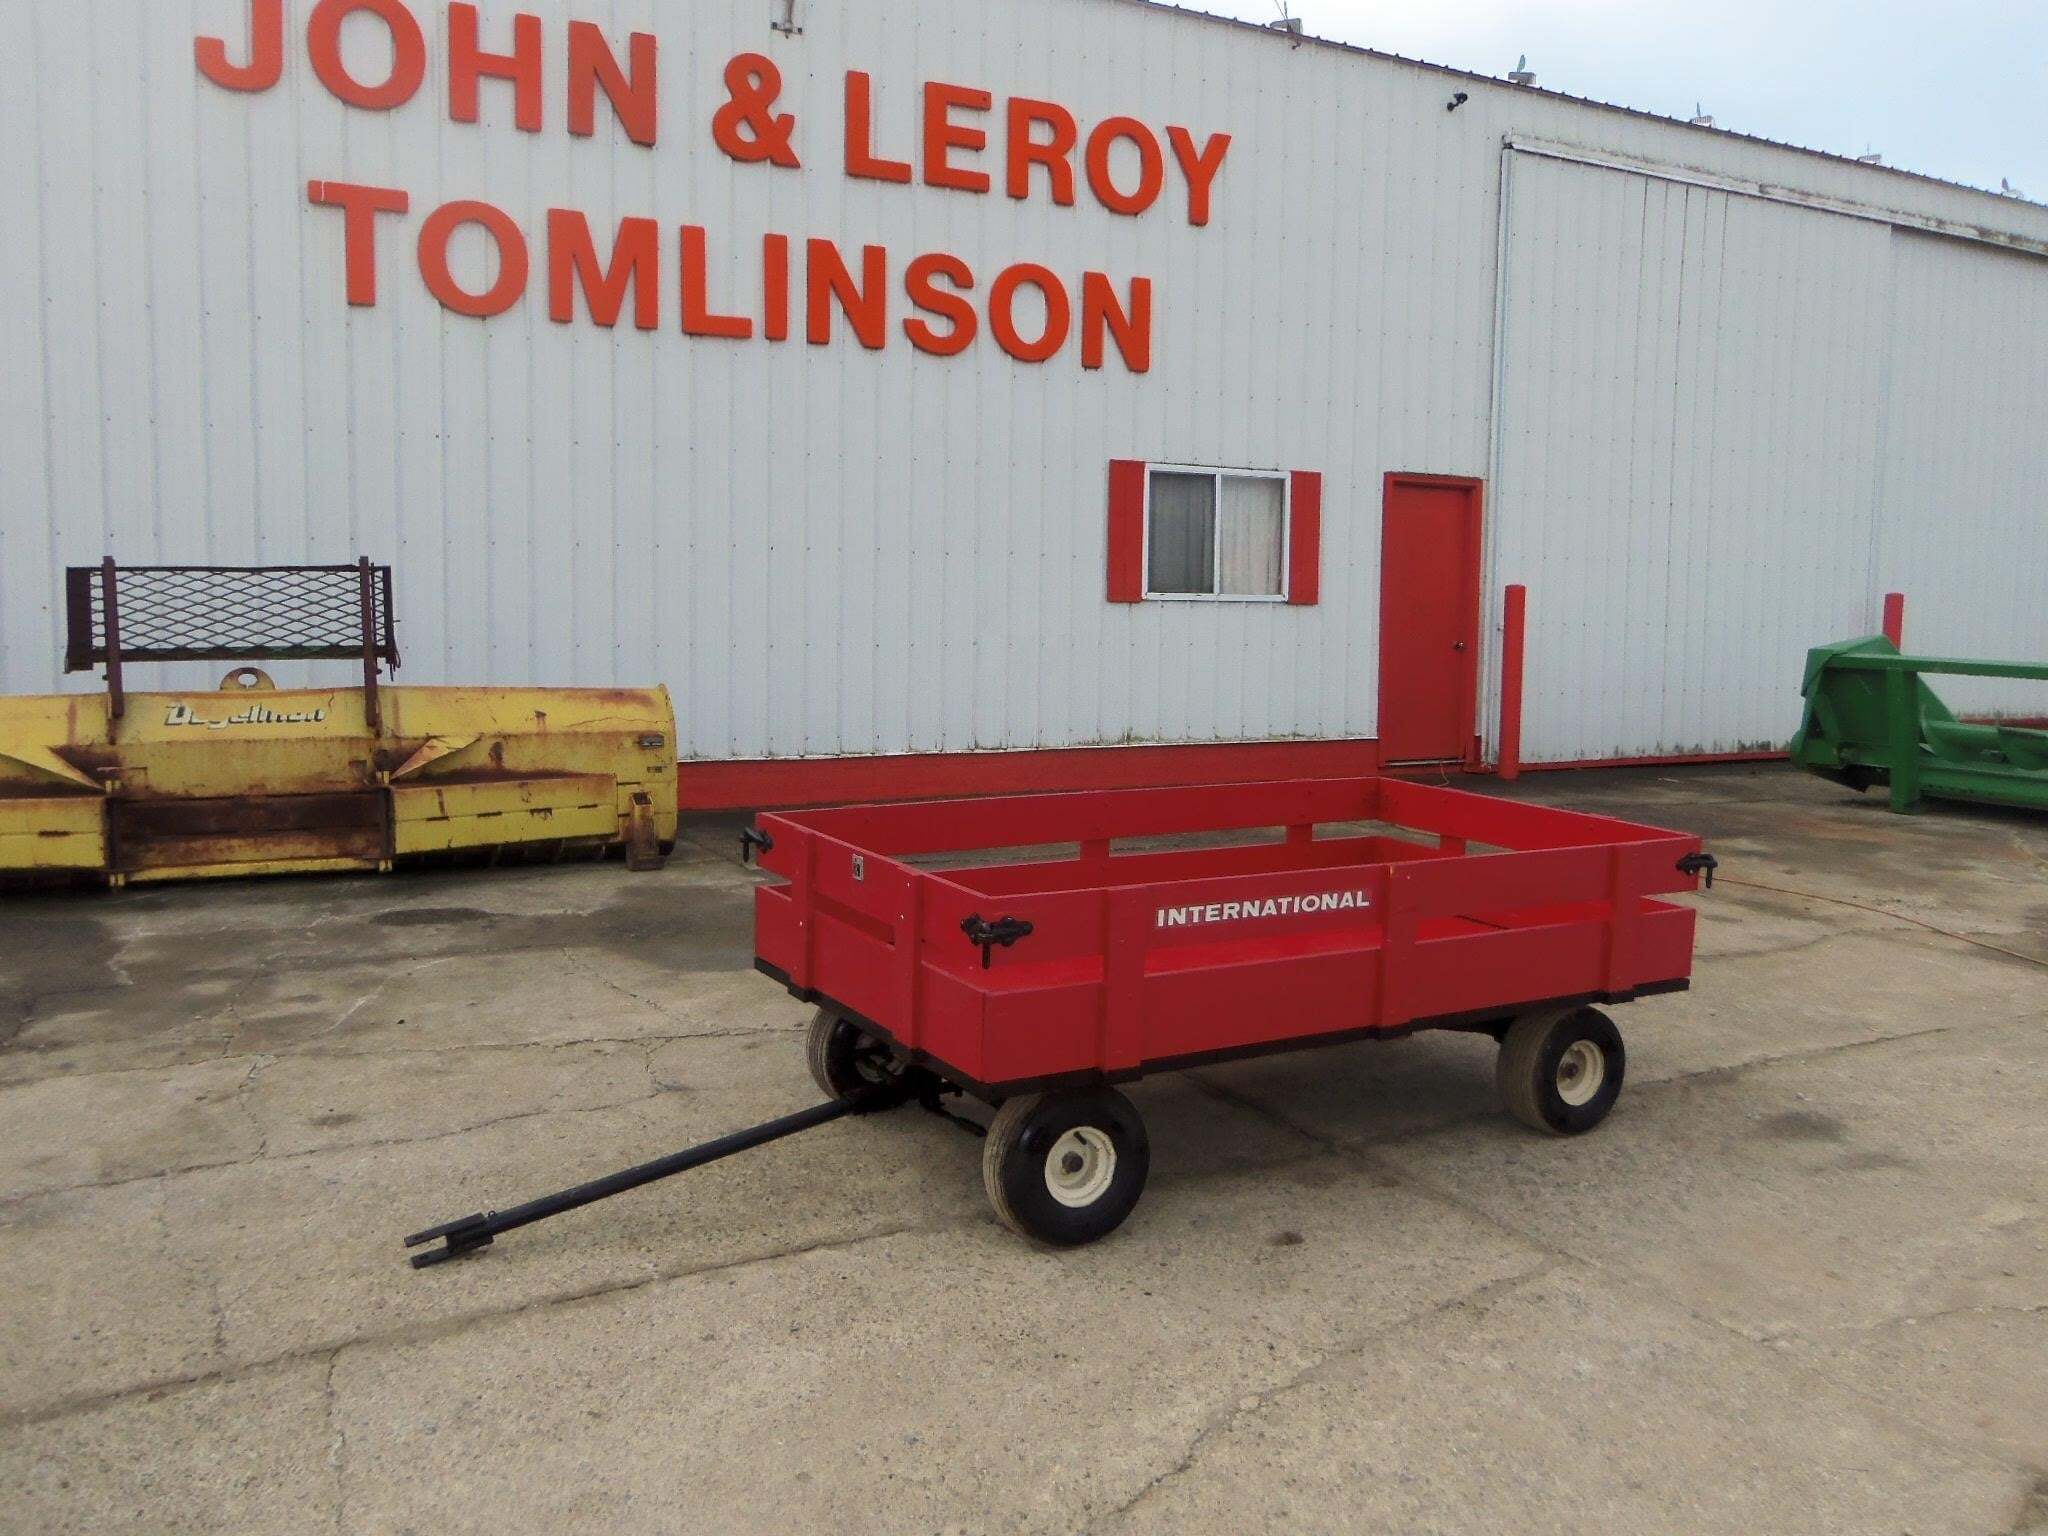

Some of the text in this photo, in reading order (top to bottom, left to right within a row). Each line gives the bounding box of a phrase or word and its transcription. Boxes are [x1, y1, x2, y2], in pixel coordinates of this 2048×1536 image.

[194, 0, 1231, 226] JOHN & LEROY
[308, 180, 1151, 374] TOMLINSON
[1156, 890, 1370, 927] INTERNATIONAL
